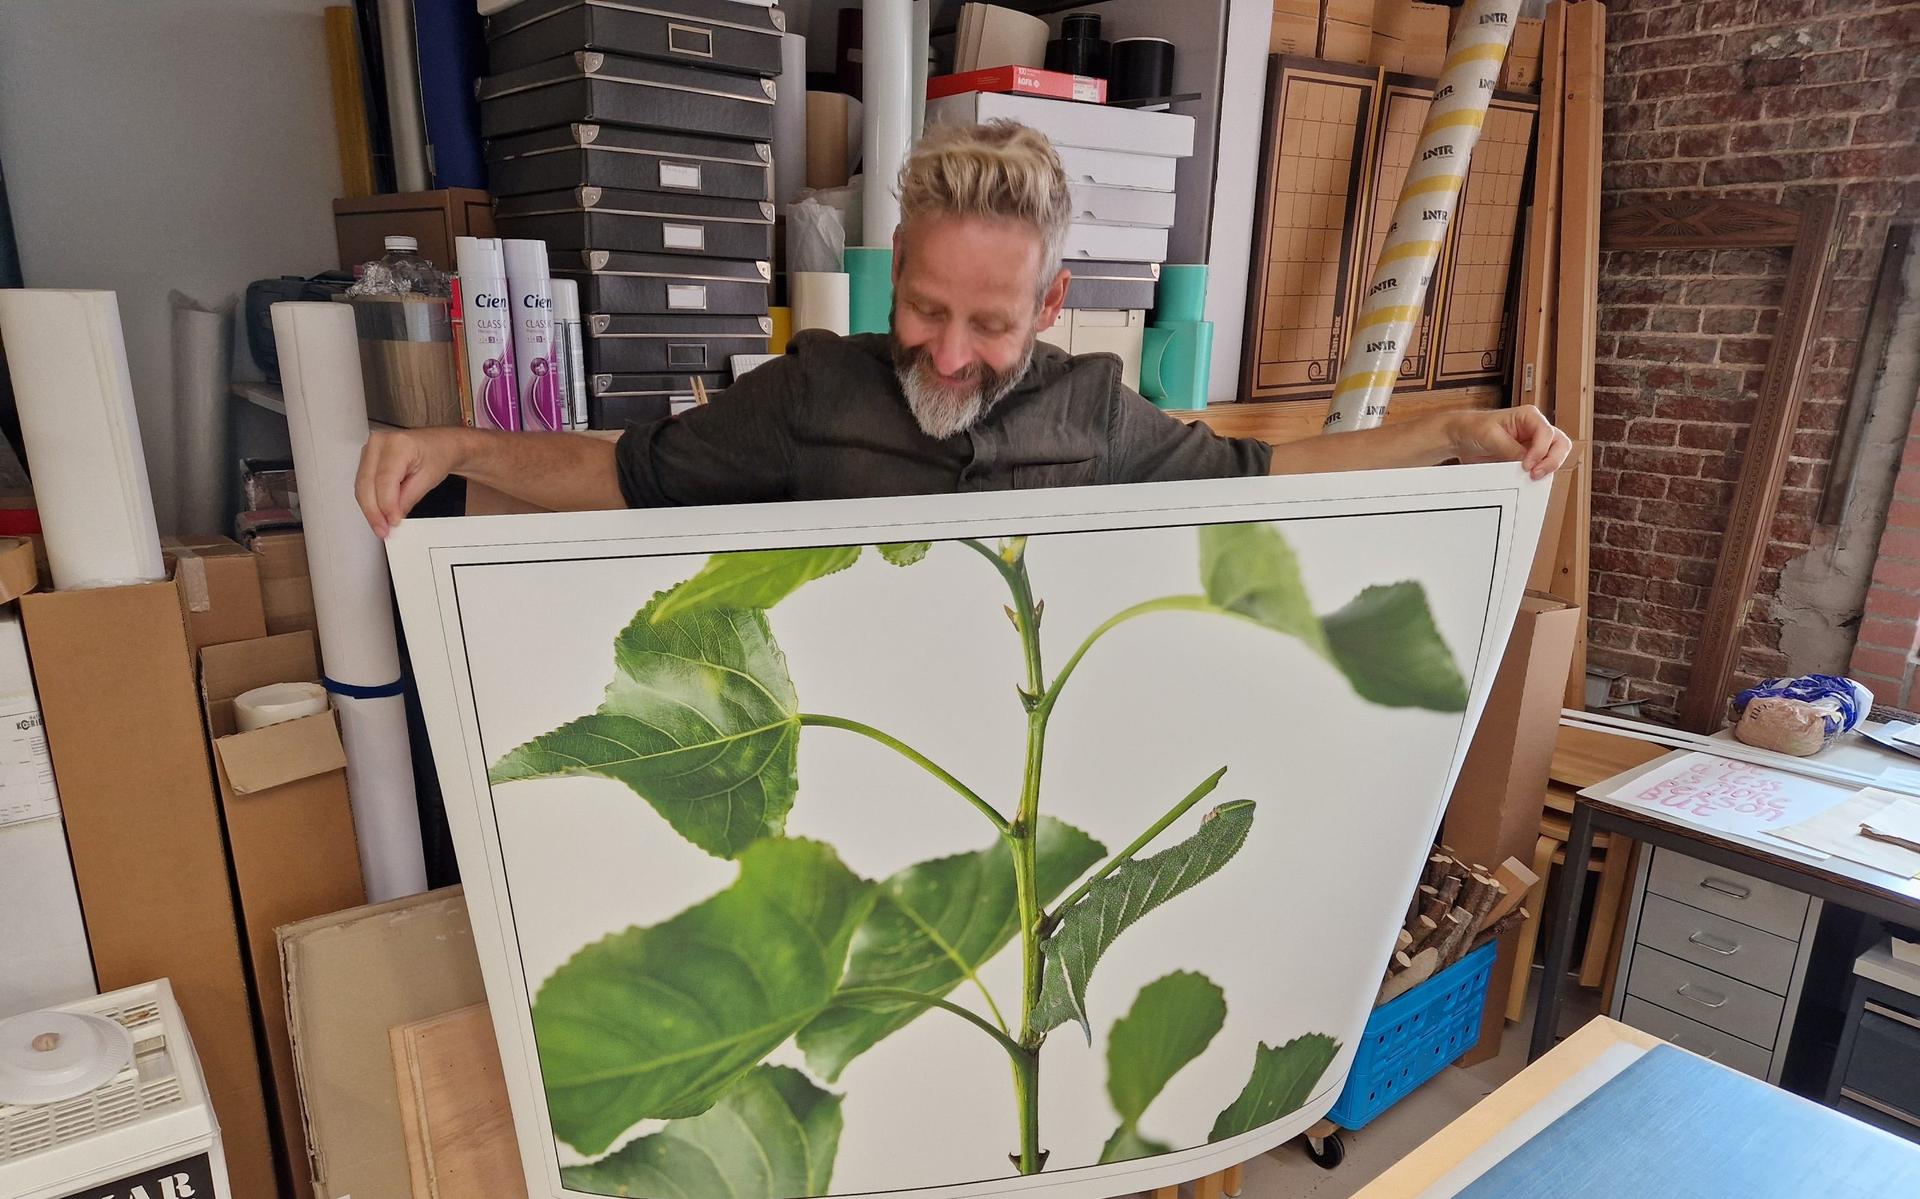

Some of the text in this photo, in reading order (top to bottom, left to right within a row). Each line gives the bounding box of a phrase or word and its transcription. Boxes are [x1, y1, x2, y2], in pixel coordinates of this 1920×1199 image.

[475, 294, 507, 308] Cien
[523, 294, 552, 308] Cien
[1330, 315, 1341, 359] Plan-Box
[1419, 315, 1431, 356] Plan-Box
